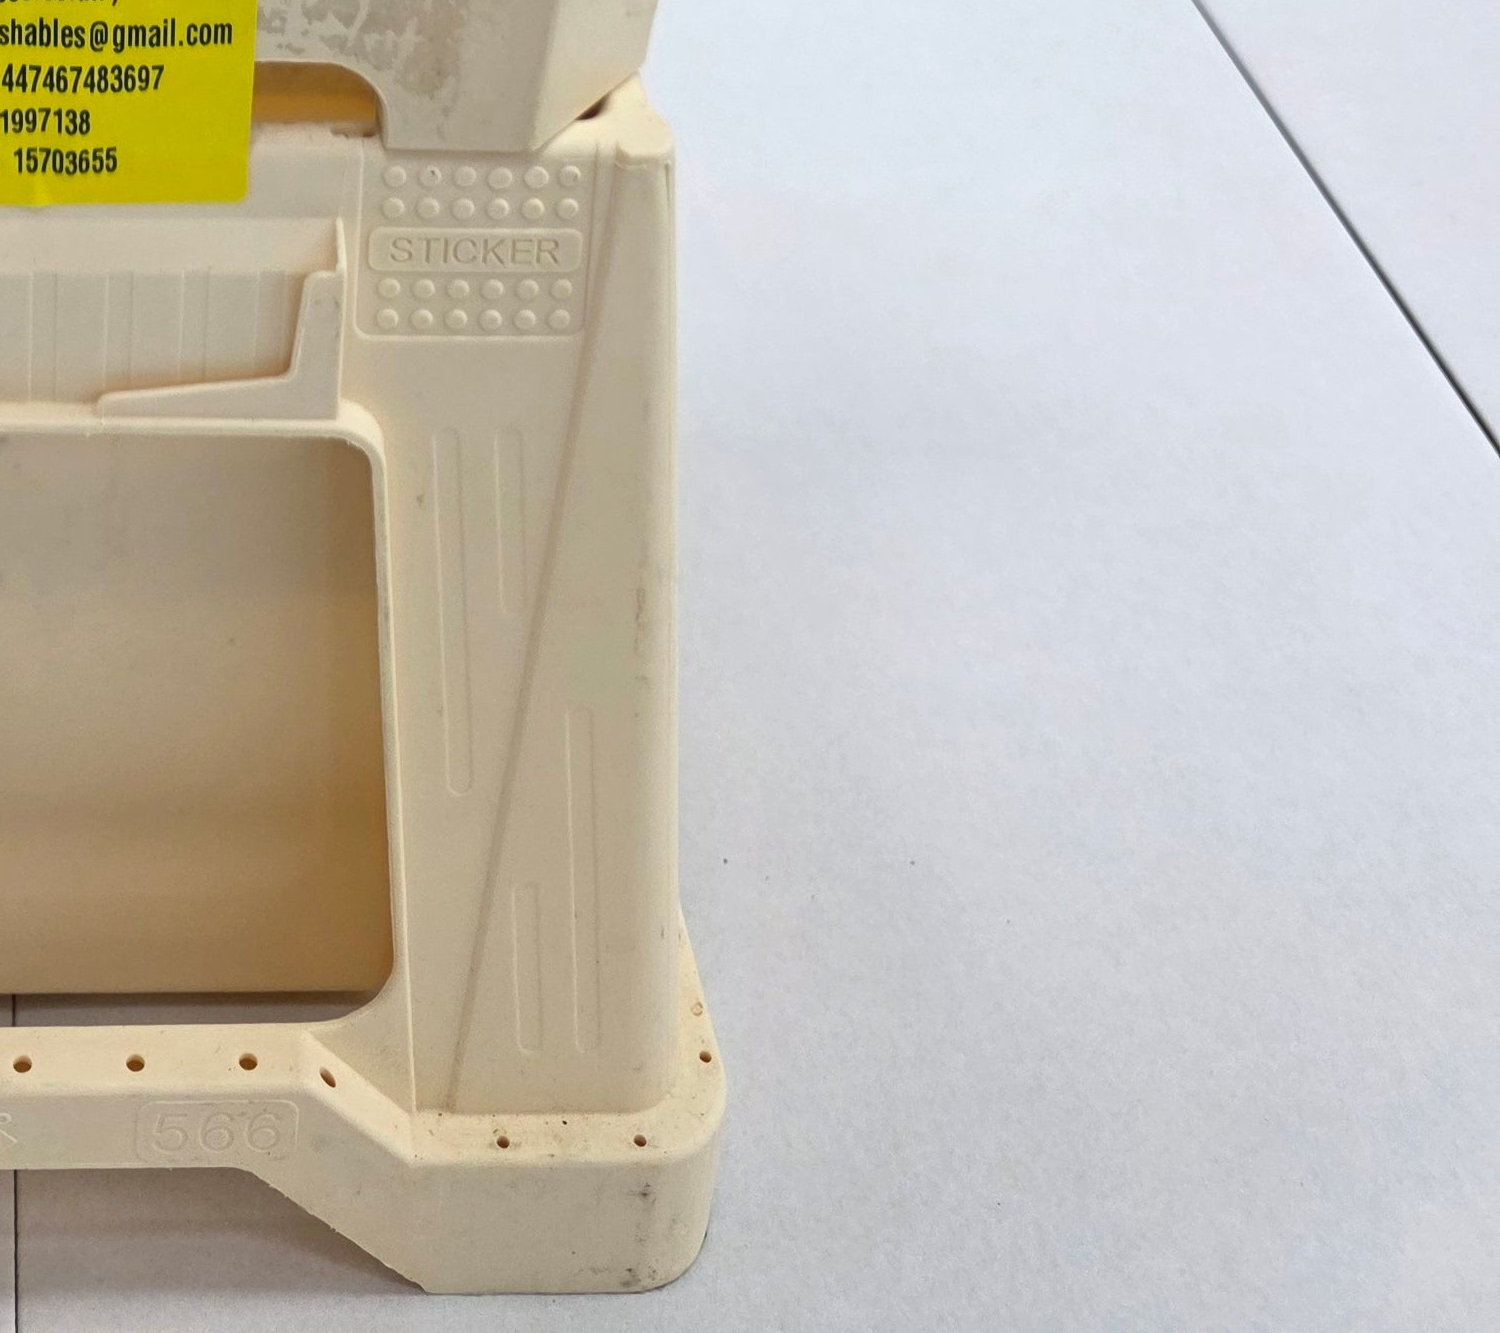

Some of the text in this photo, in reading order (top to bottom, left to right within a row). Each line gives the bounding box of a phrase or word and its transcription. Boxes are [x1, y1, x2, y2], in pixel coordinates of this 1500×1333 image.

[13, 145, 118, 176] 15703655
[389, 236, 560, 267] STICKER
[151, 1112, 282, 1154] 566
